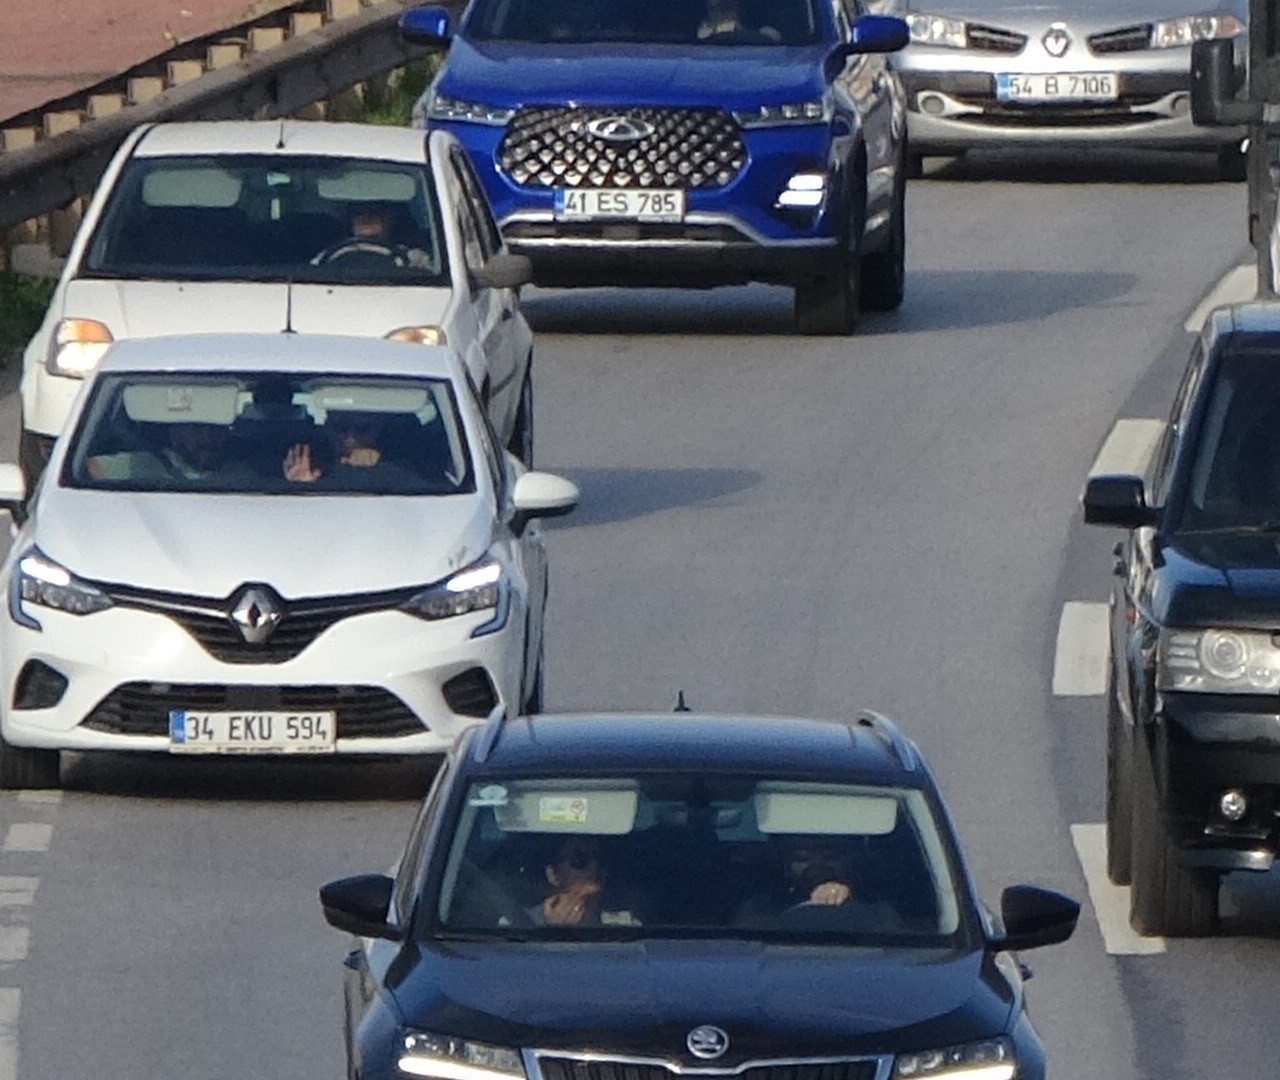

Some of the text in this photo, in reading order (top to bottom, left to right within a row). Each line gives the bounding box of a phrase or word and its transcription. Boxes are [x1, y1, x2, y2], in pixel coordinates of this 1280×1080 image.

[1010, 77, 1033, 95] 54
[1044, 76, 1059, 95] B
[566, 192, 676, 213] 41 ES 785
[187, 716, 327, 741] 34 EKU 594
